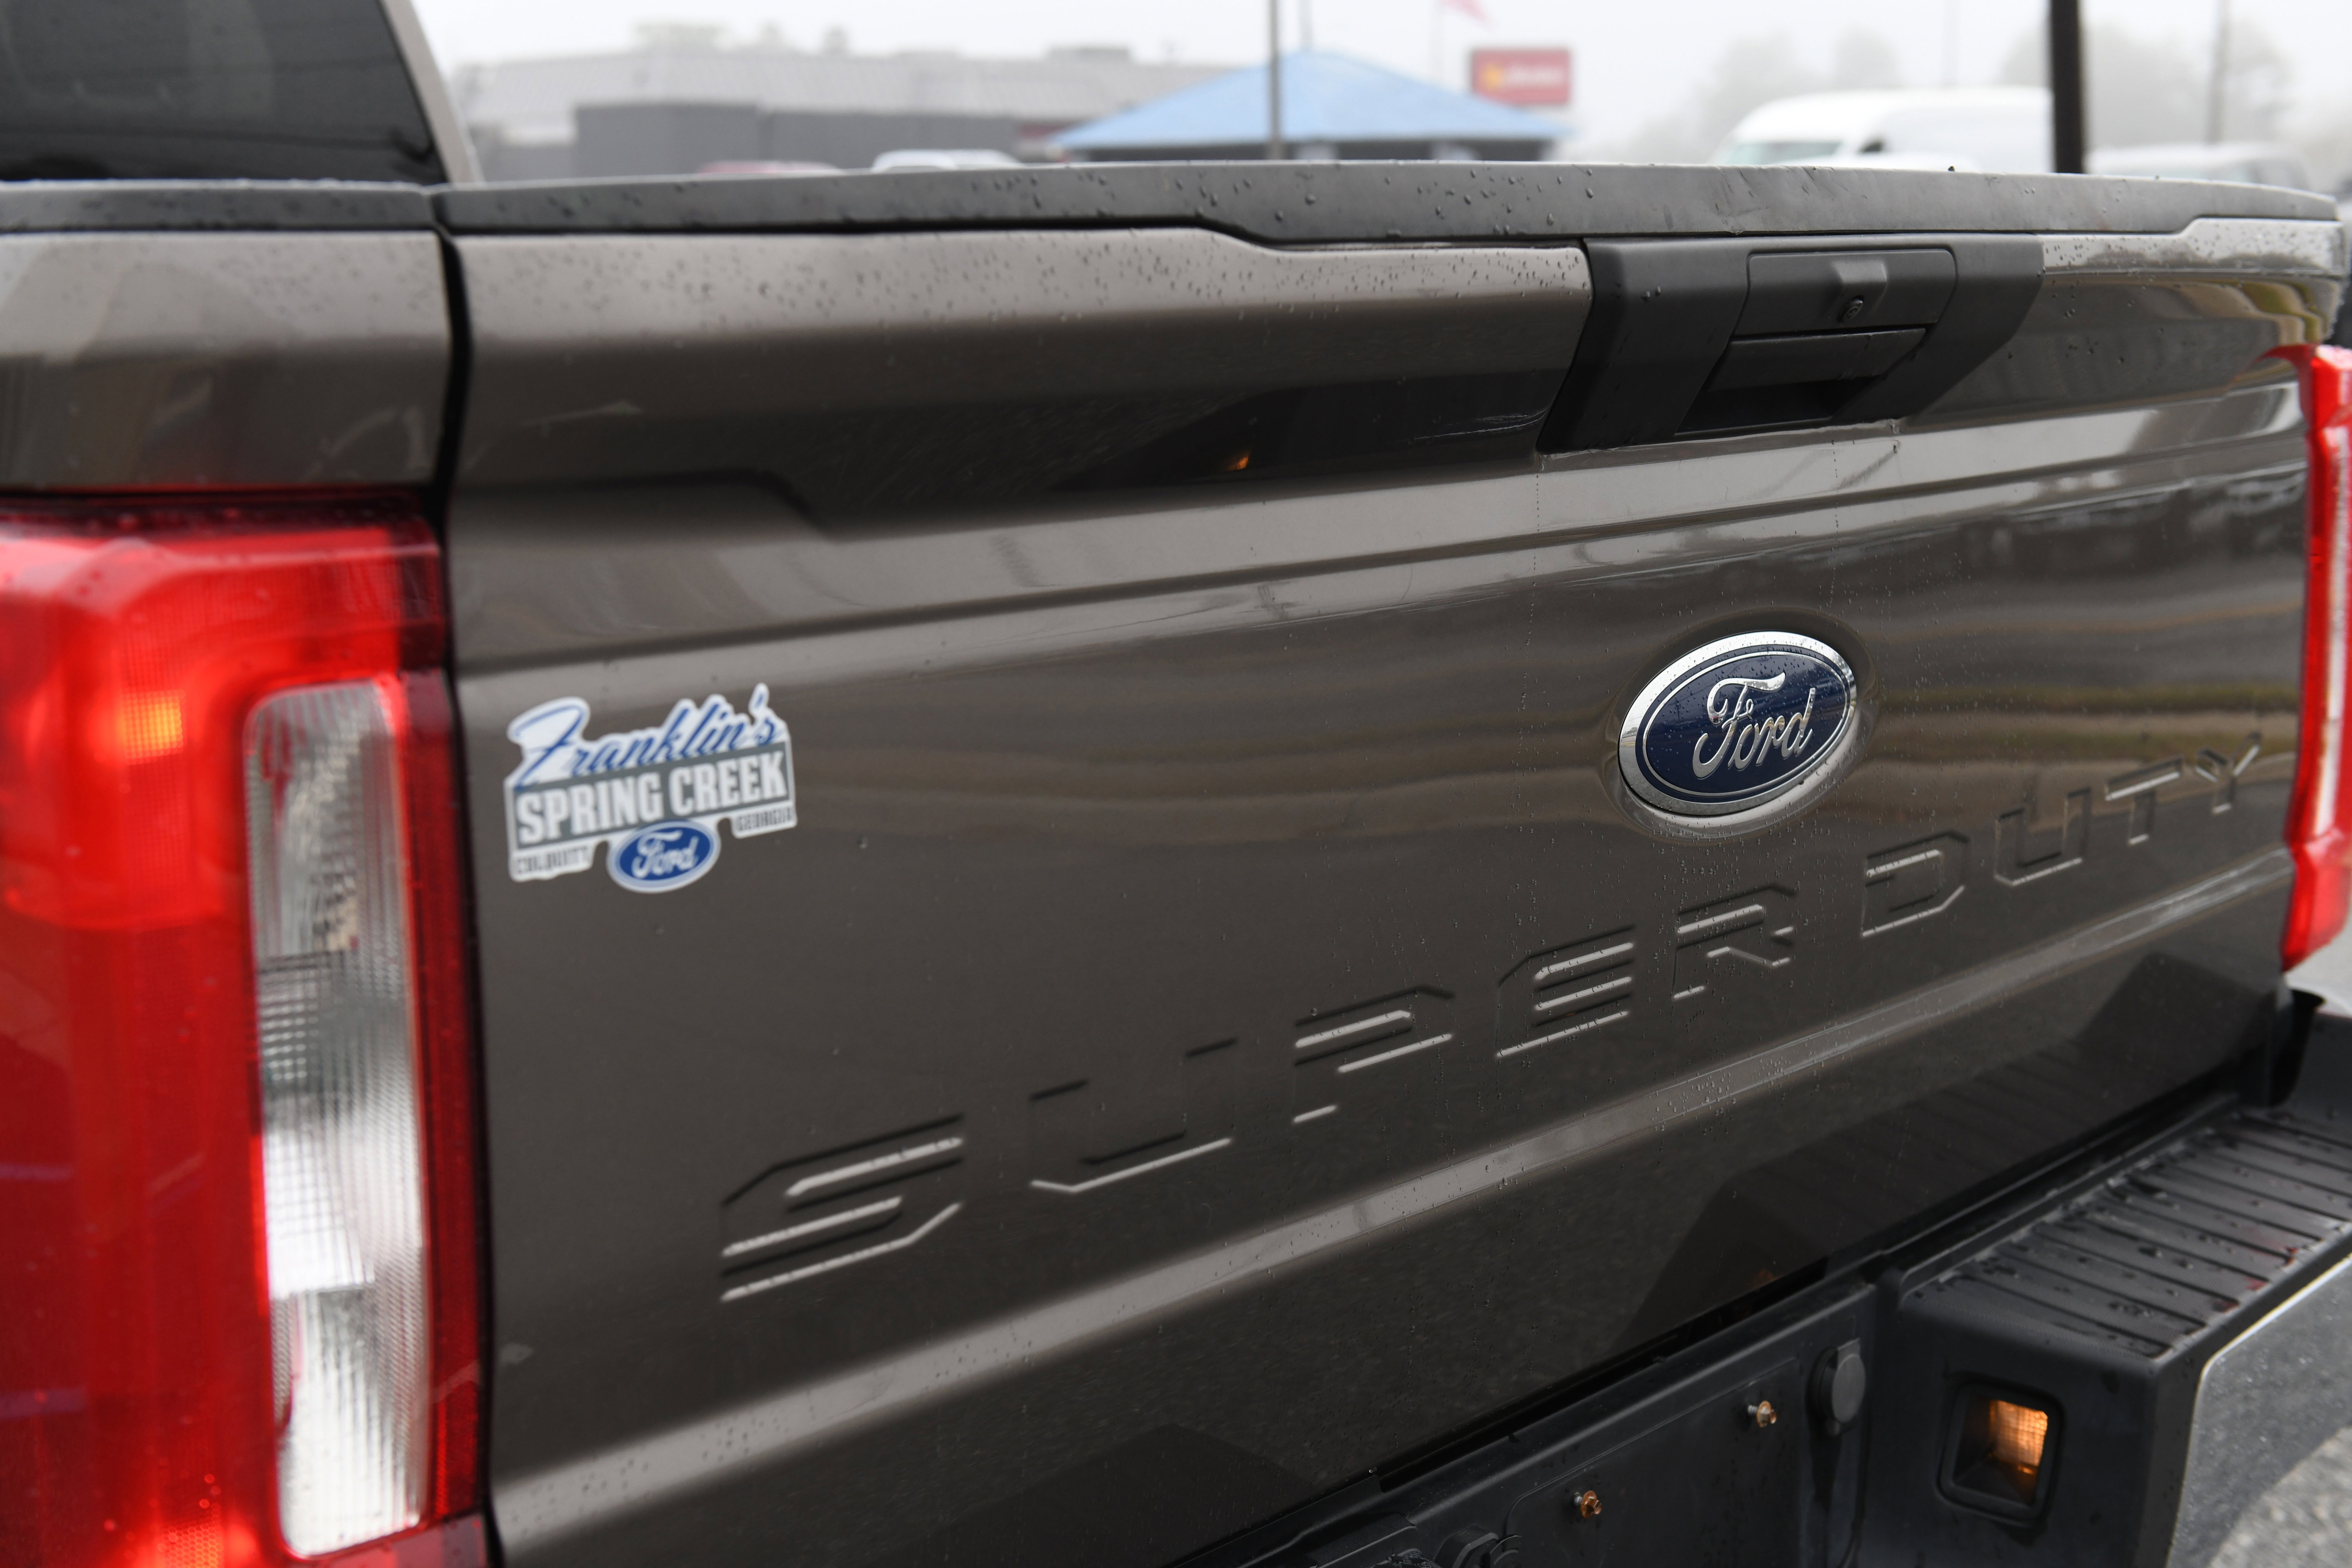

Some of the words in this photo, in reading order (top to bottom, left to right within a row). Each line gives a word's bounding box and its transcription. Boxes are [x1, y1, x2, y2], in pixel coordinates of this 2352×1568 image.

[514, 692, 783, 791] Franklin's
[1692, 672, 1816, 780] Ford
[516, 772, 664, 844] SPRING
[669, 751, 788, 817] CREEK
[737, 807, 792, 831] GEORGIA
[631, 829, 699, 878] Ford
[722, 884, 1796, 1302] SUPER
[1861, 732, 2262, 937] DUTY
